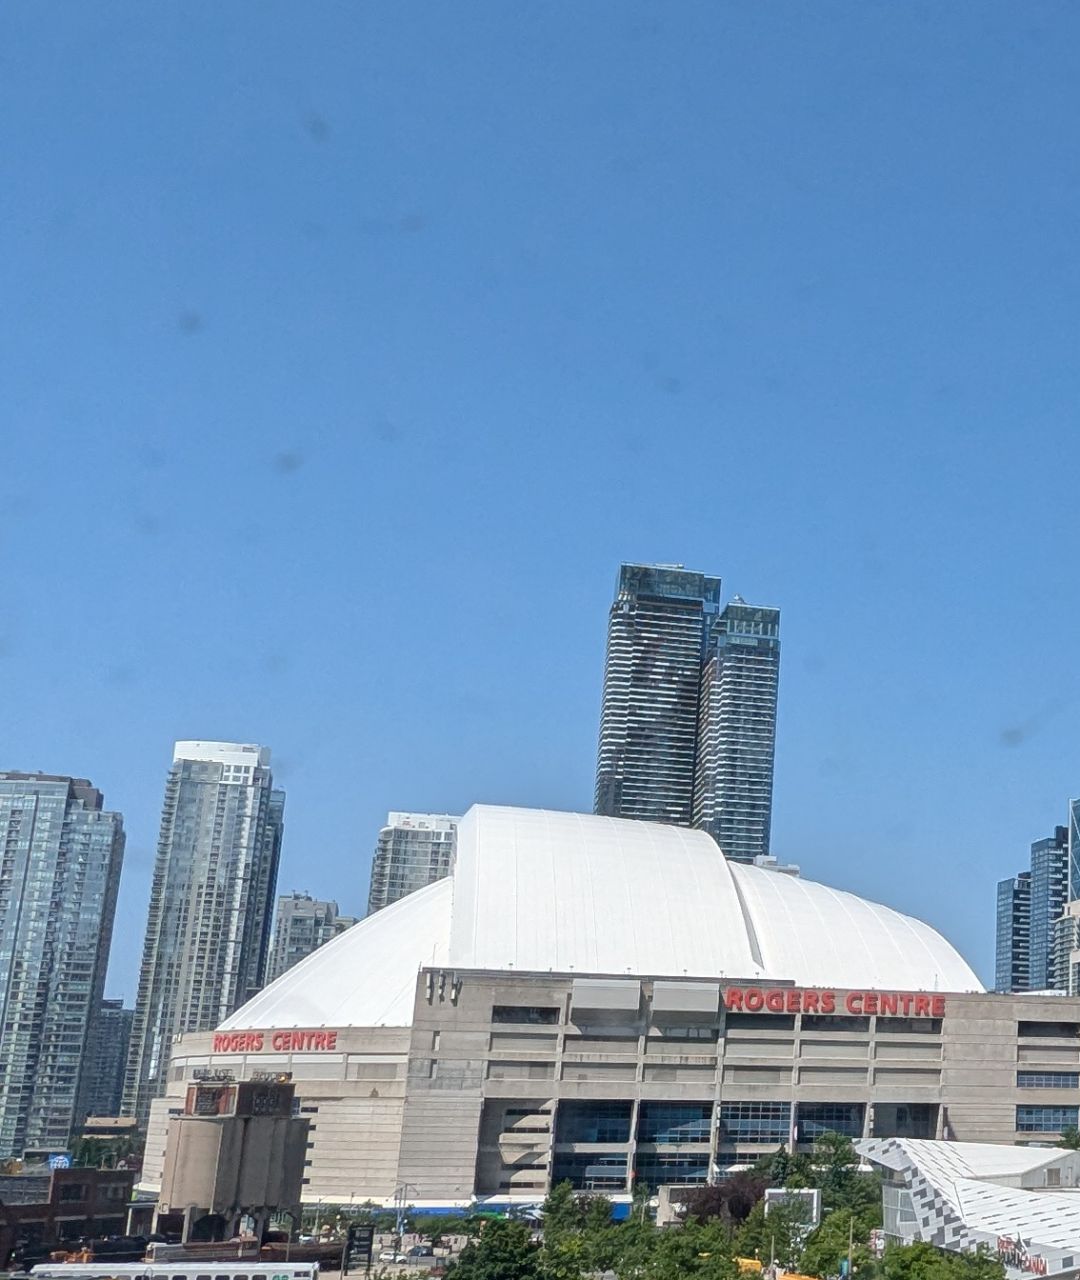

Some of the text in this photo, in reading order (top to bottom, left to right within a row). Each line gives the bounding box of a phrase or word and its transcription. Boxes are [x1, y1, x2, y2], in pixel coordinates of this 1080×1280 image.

[724, 987, 946, 1017] ROGERS CENTRE
[213, 1031, 338, 1053] ROGERS CENTRE
